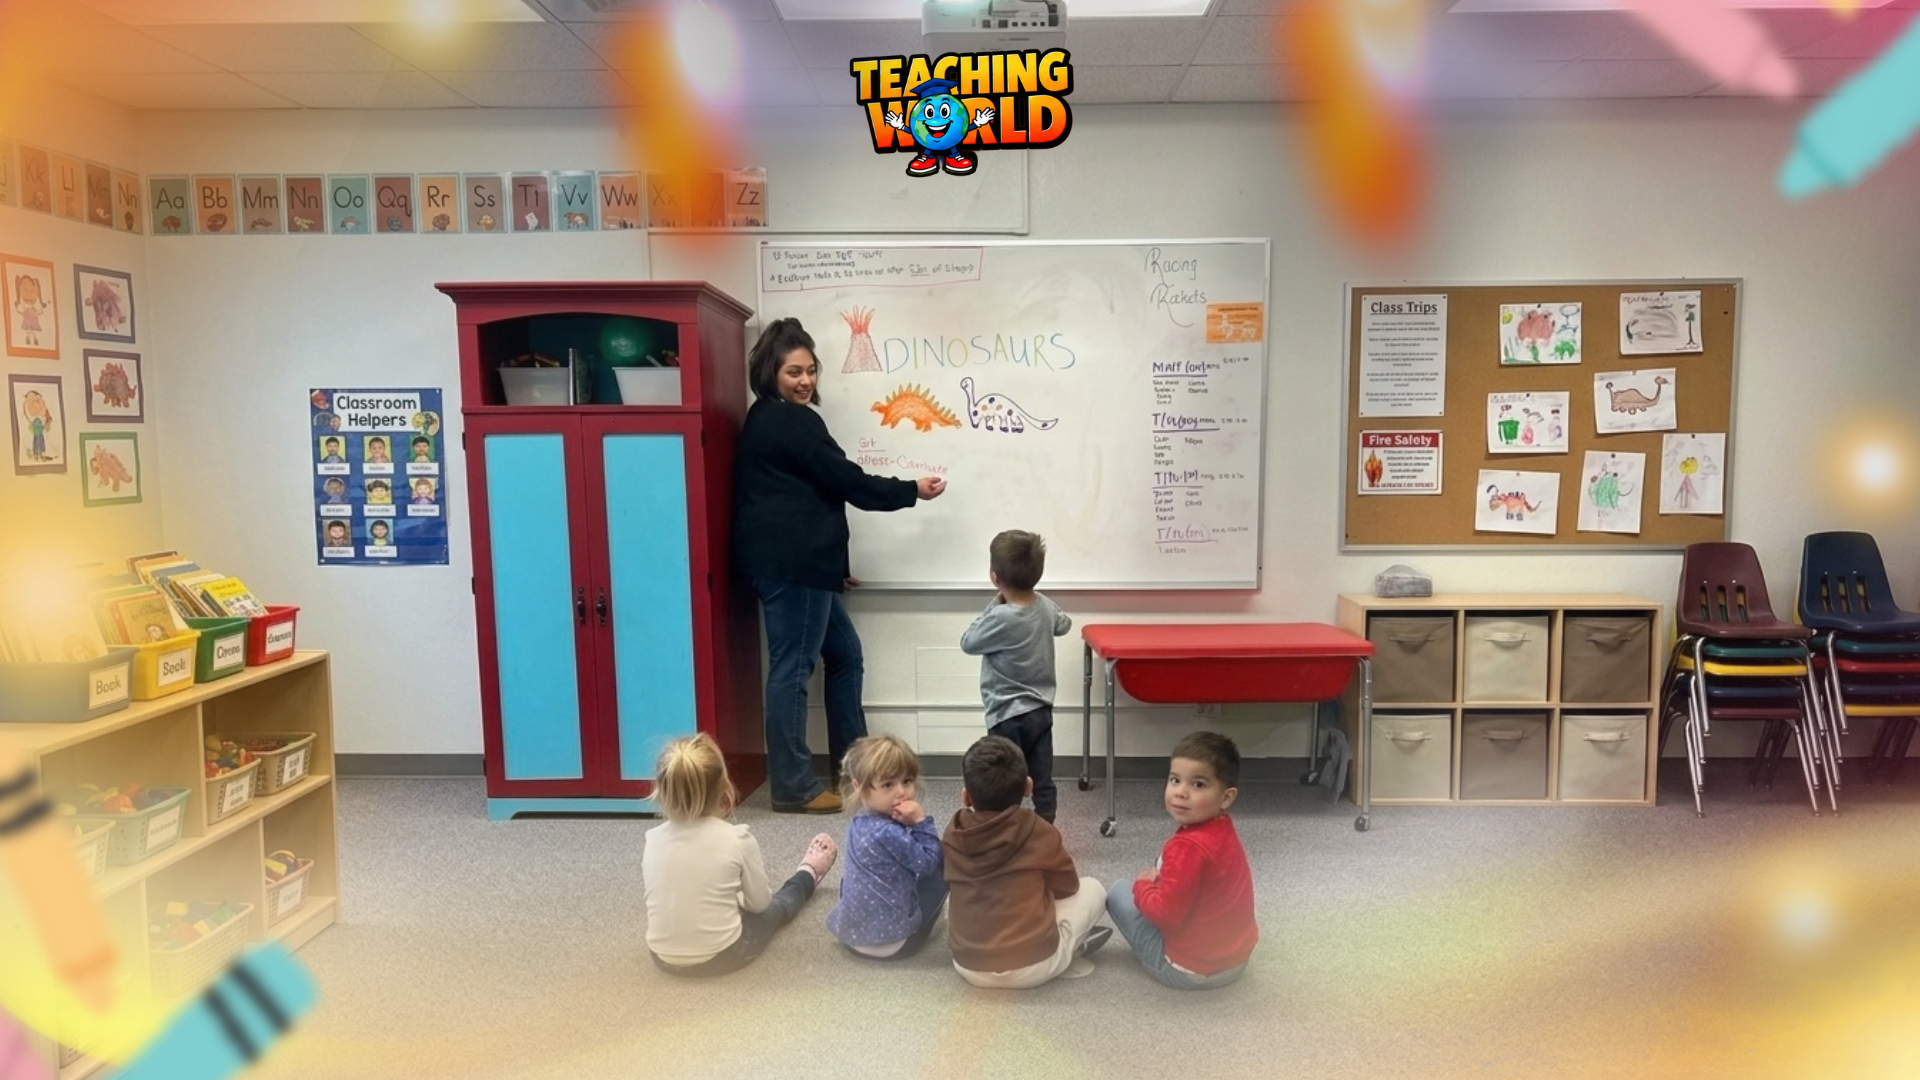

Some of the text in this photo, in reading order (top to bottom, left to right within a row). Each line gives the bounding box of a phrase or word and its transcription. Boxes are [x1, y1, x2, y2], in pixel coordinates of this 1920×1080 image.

[24, 154, 46, 185] Kk
[117, 181, 138, 208] Nn
[156, 187, 185, 209] Aa
[201, 186, 228, 209] Bb
[242, 186, 279, 209] Mm
[290, 186, 319, 209] Nn
[333, 186, 364, 208] Oo
[378, 185, 412, 217] Qq
[427, 185, 450, 208] Rr
[474, 185, 496, 207] Ss
[561, 184, 588, 206] Vv
[601, 184, 638, 207] Ww
[652, 183, 678, 206] Xx
[735, 182, 760, 205] Zz
[1144, 247, 1197, 281] Racing
[1370, 301, 1438, 315] Class Trips
[883, 332, 1076, 375] DINOSAURS
[337, 395, 418, 410] Classroom
[348, 412, 407, 429] Helpers
[1369, 435, 1432, 447] Fire Safety
[96, 674, 122, 695] Book
